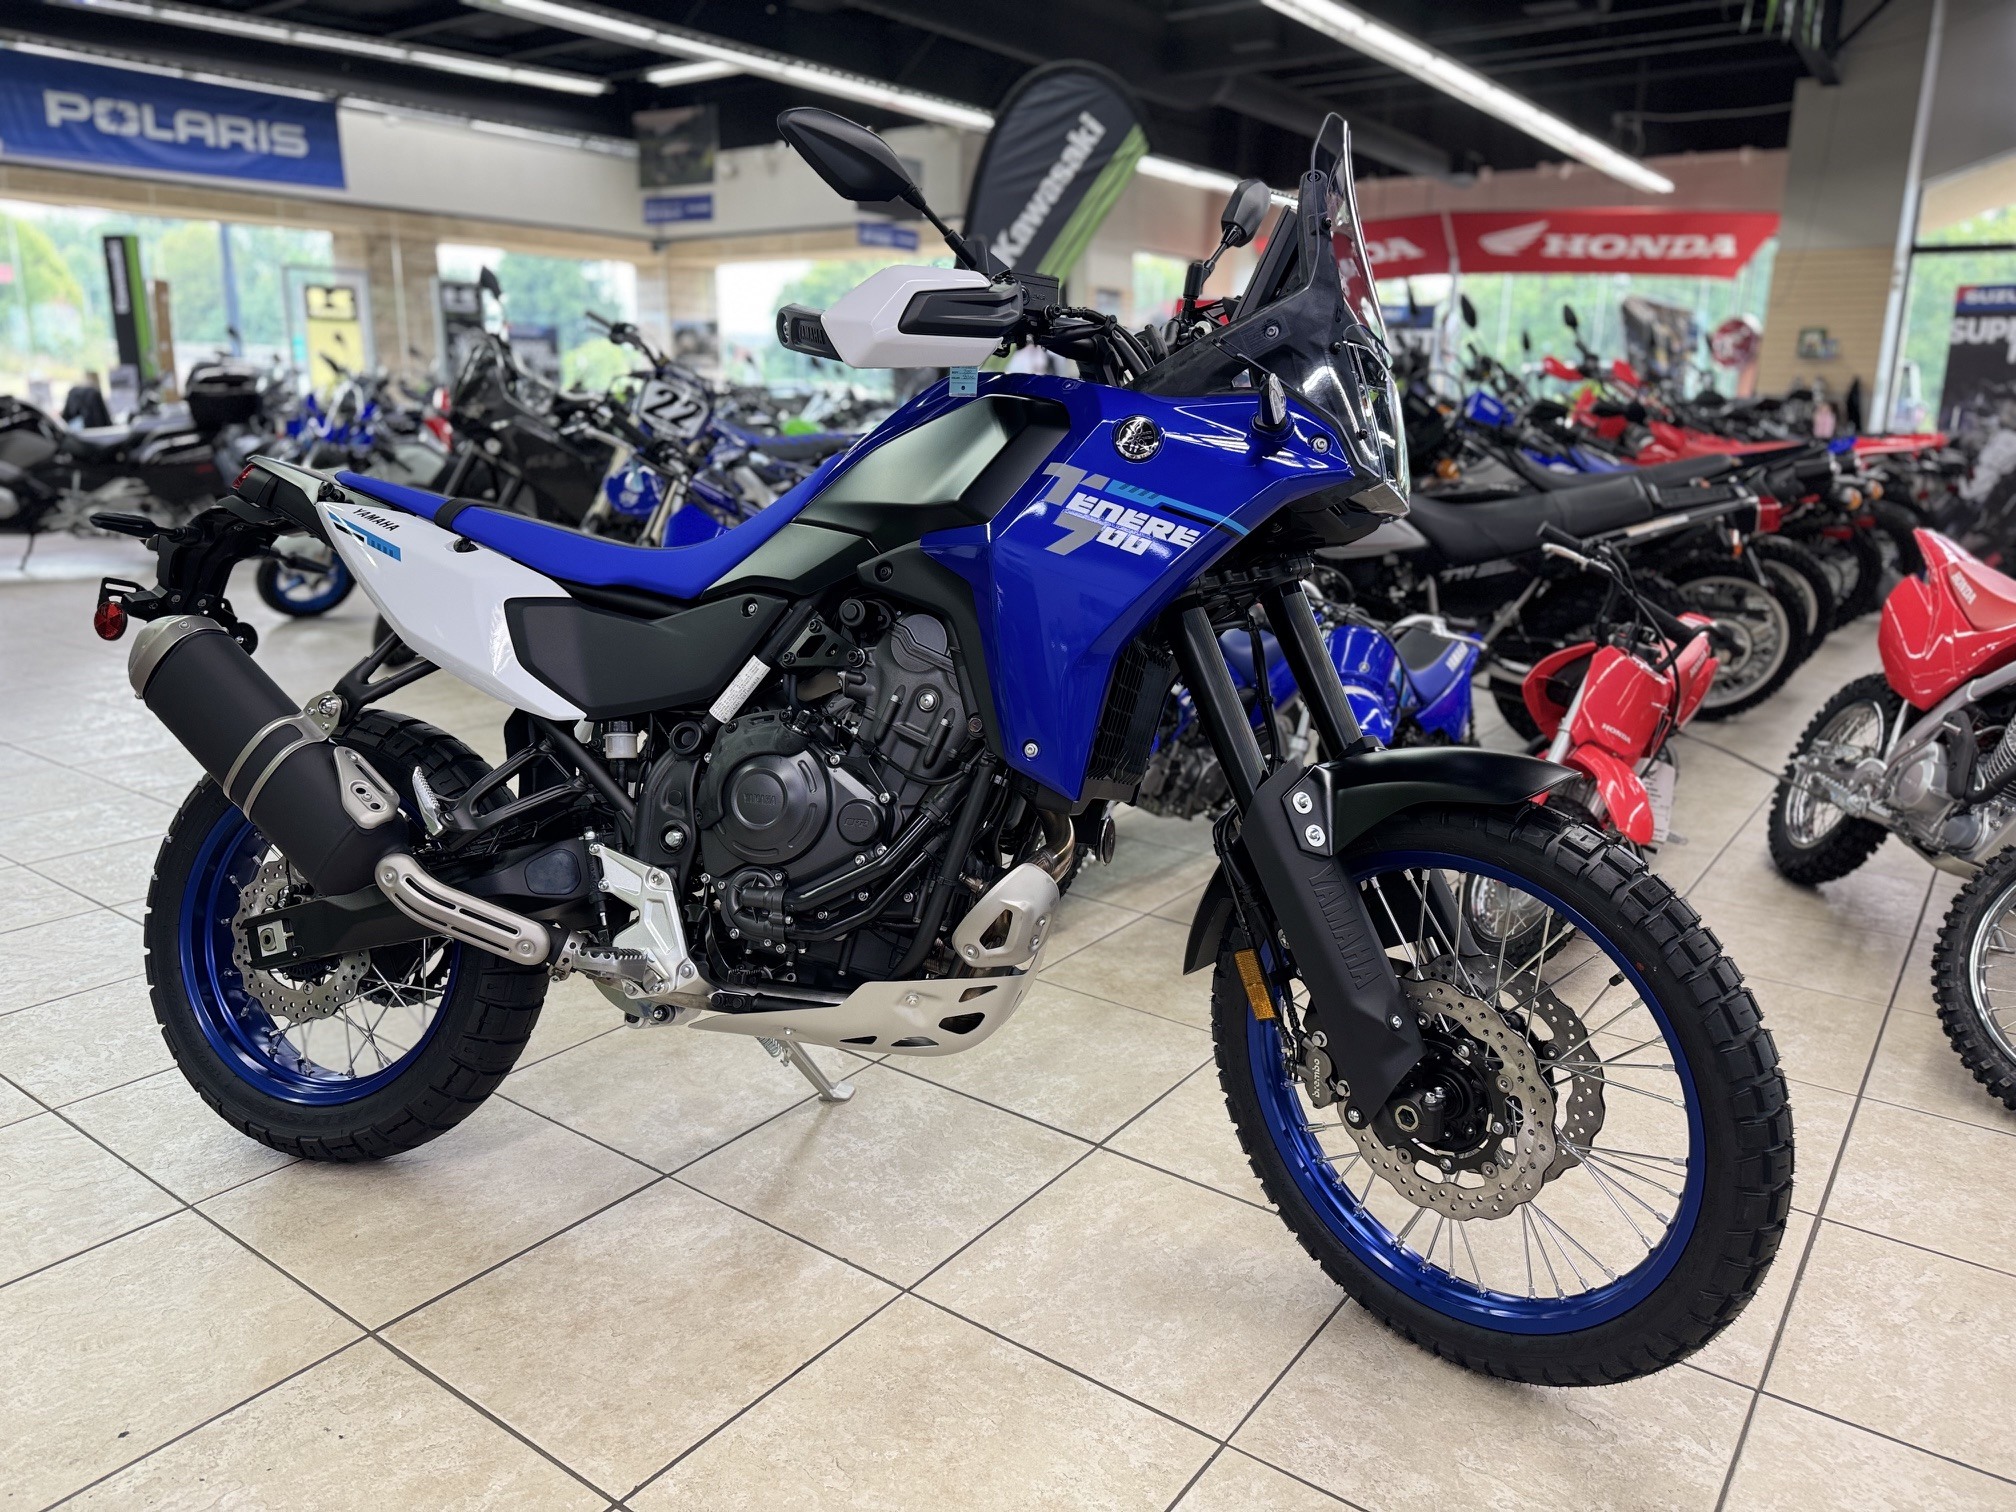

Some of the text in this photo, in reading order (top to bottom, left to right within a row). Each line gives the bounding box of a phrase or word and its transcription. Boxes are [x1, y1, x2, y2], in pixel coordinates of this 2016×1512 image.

[43, 89, 309, 158] POLARIS
[990, 110, 1106, 271] Kawasaki
[1541, 232, 1738, 259] HONDA
[643, 388, 704, 429] 22
[352, 507, 401, 533] YAMAHA
[1044, 507, 1154, 557] 700
[1308, 863, 1382, 991] YAMAHA
[1312, 1058, 1321, 1098] brembo
